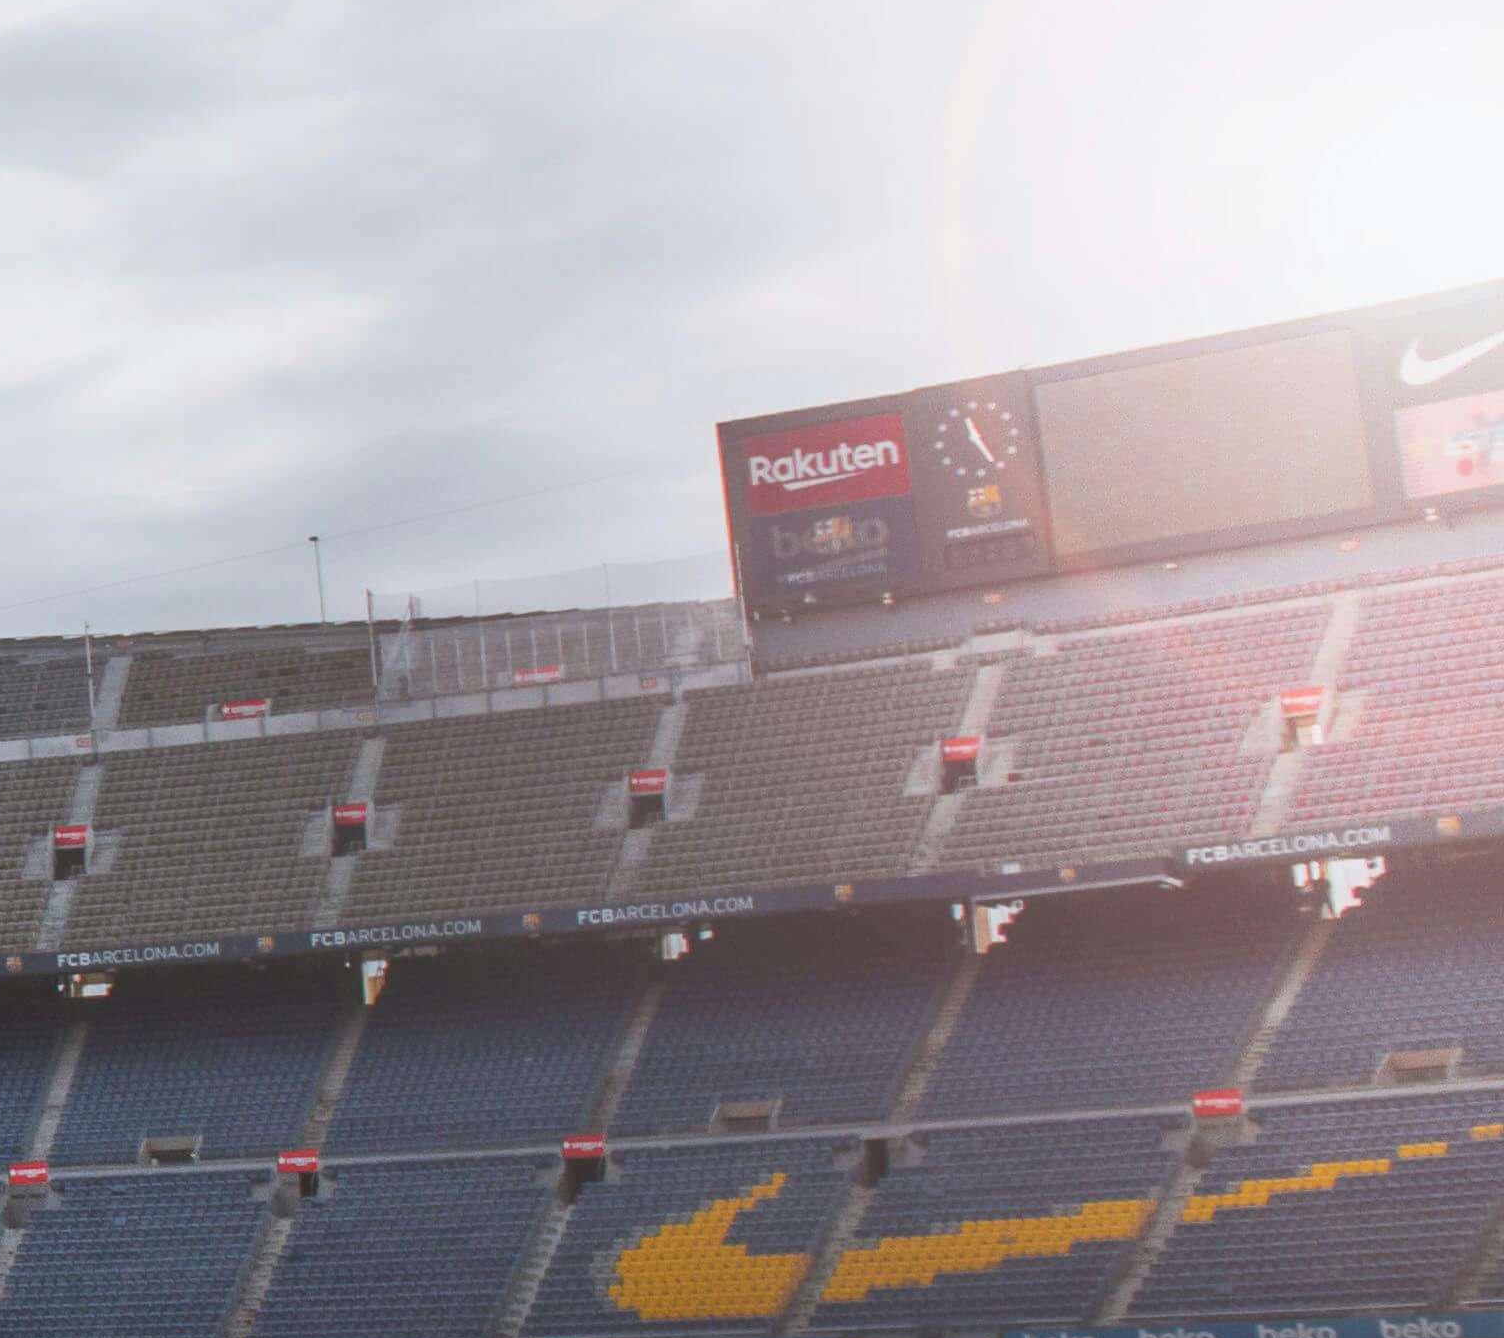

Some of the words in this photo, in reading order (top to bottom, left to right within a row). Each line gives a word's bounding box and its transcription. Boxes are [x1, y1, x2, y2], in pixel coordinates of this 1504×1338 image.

[750, 440, 899, 486] Rakuten
[1188, 827, 1390, 864] FCBARCELONA.COM
[578, 896, 753, 924] FCBARCELONA.COM
[311, 920, 481, 947] FCBARCELONA.COM
[57, 943, 220, 968] FCBARCELONA.COM
